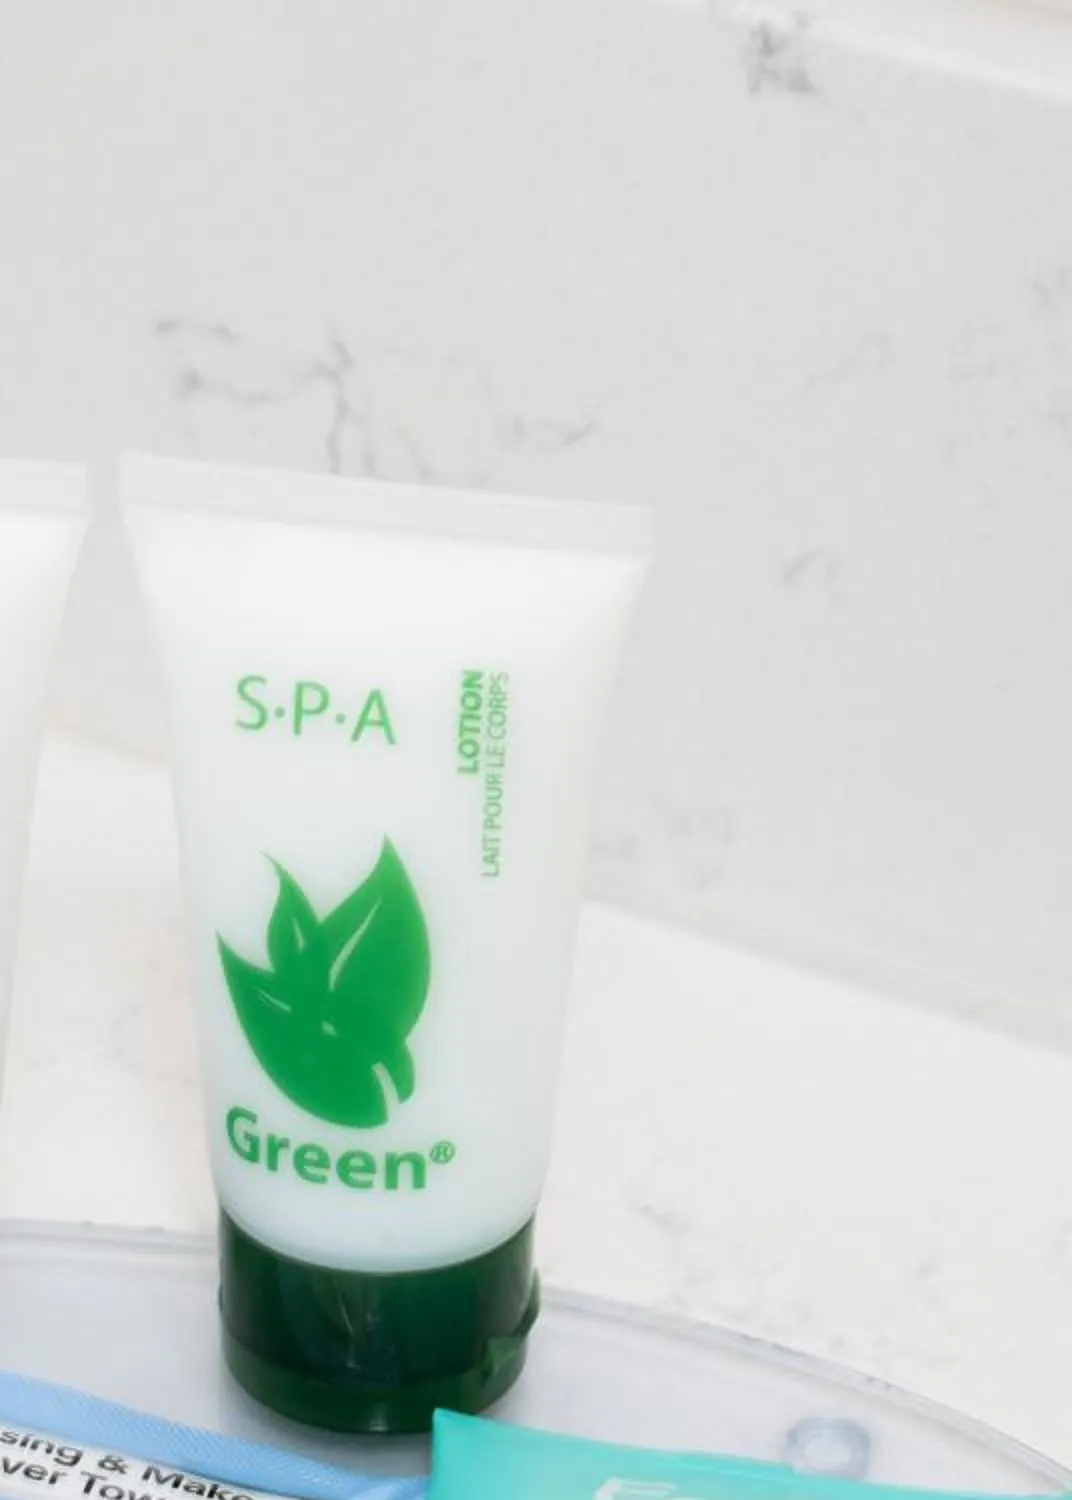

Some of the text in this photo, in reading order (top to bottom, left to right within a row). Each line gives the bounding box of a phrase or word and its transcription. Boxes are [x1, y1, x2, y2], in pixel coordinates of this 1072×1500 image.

[456, 669, 484, 775] LOTION
[480, 671, 510, 878] LAIT POUR LE CORPS
[98, 1453, 129, 1476] &
